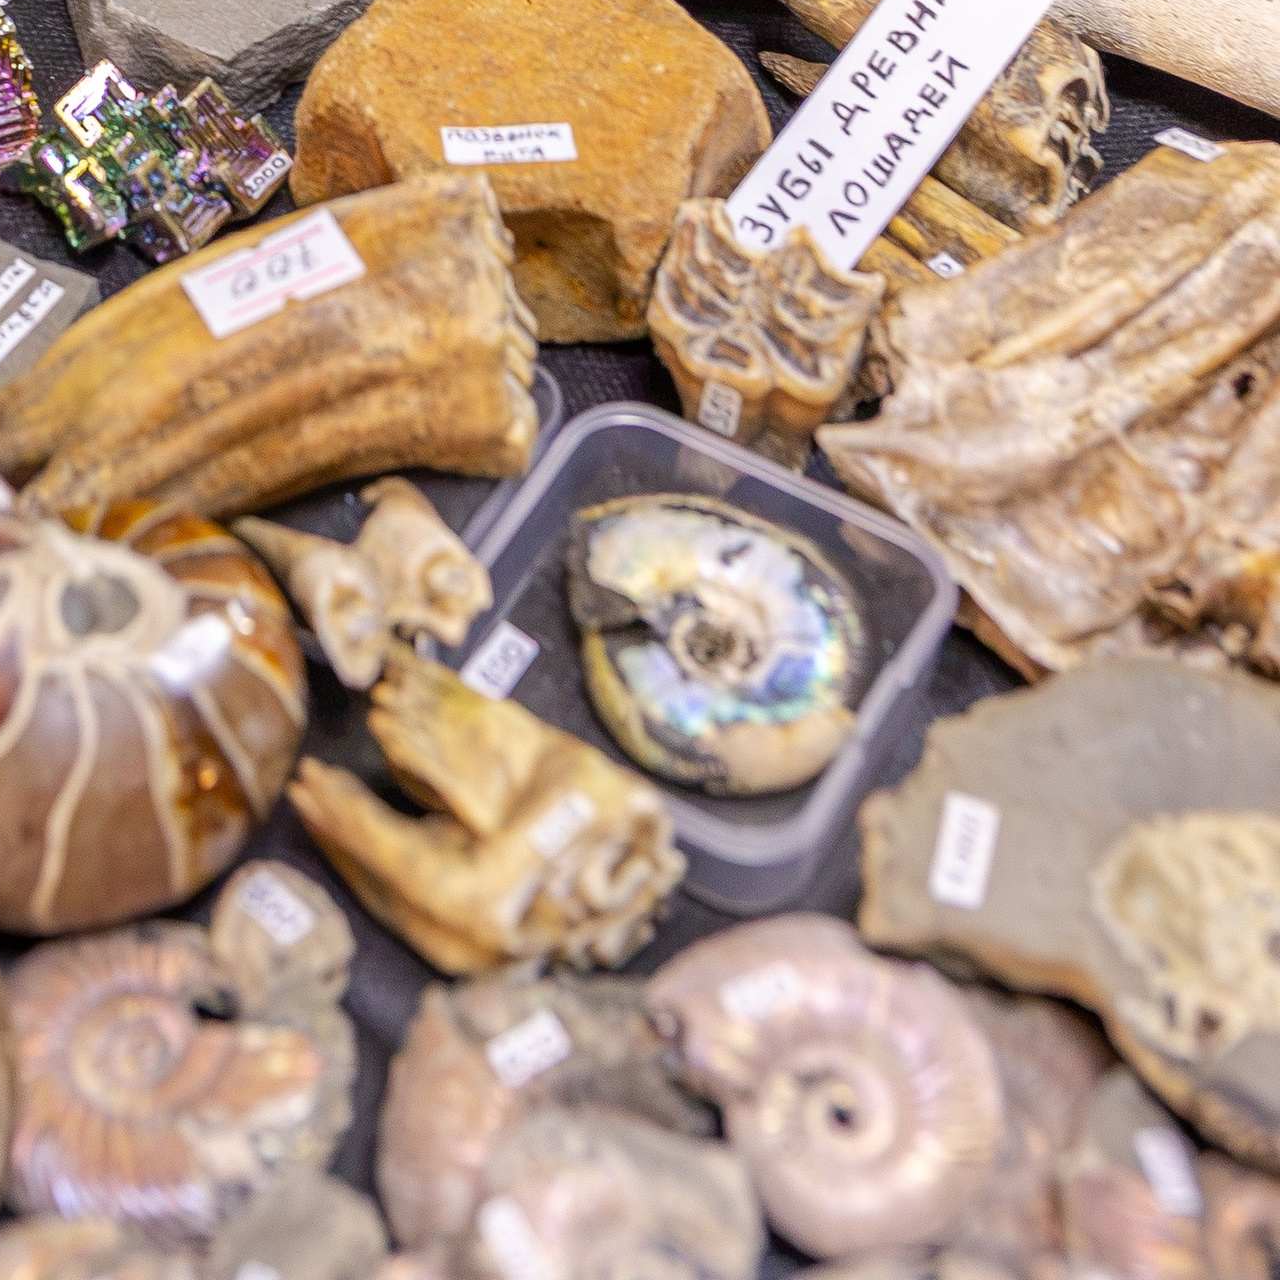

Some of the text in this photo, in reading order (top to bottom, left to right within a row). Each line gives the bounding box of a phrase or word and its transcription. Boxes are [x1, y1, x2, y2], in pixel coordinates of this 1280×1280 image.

[248, 157, 286, 194] 1000
[739, 142, 835, 243] ЗУБЫ
[827, 52, 971, 237] ЛОШАДЕЙ
